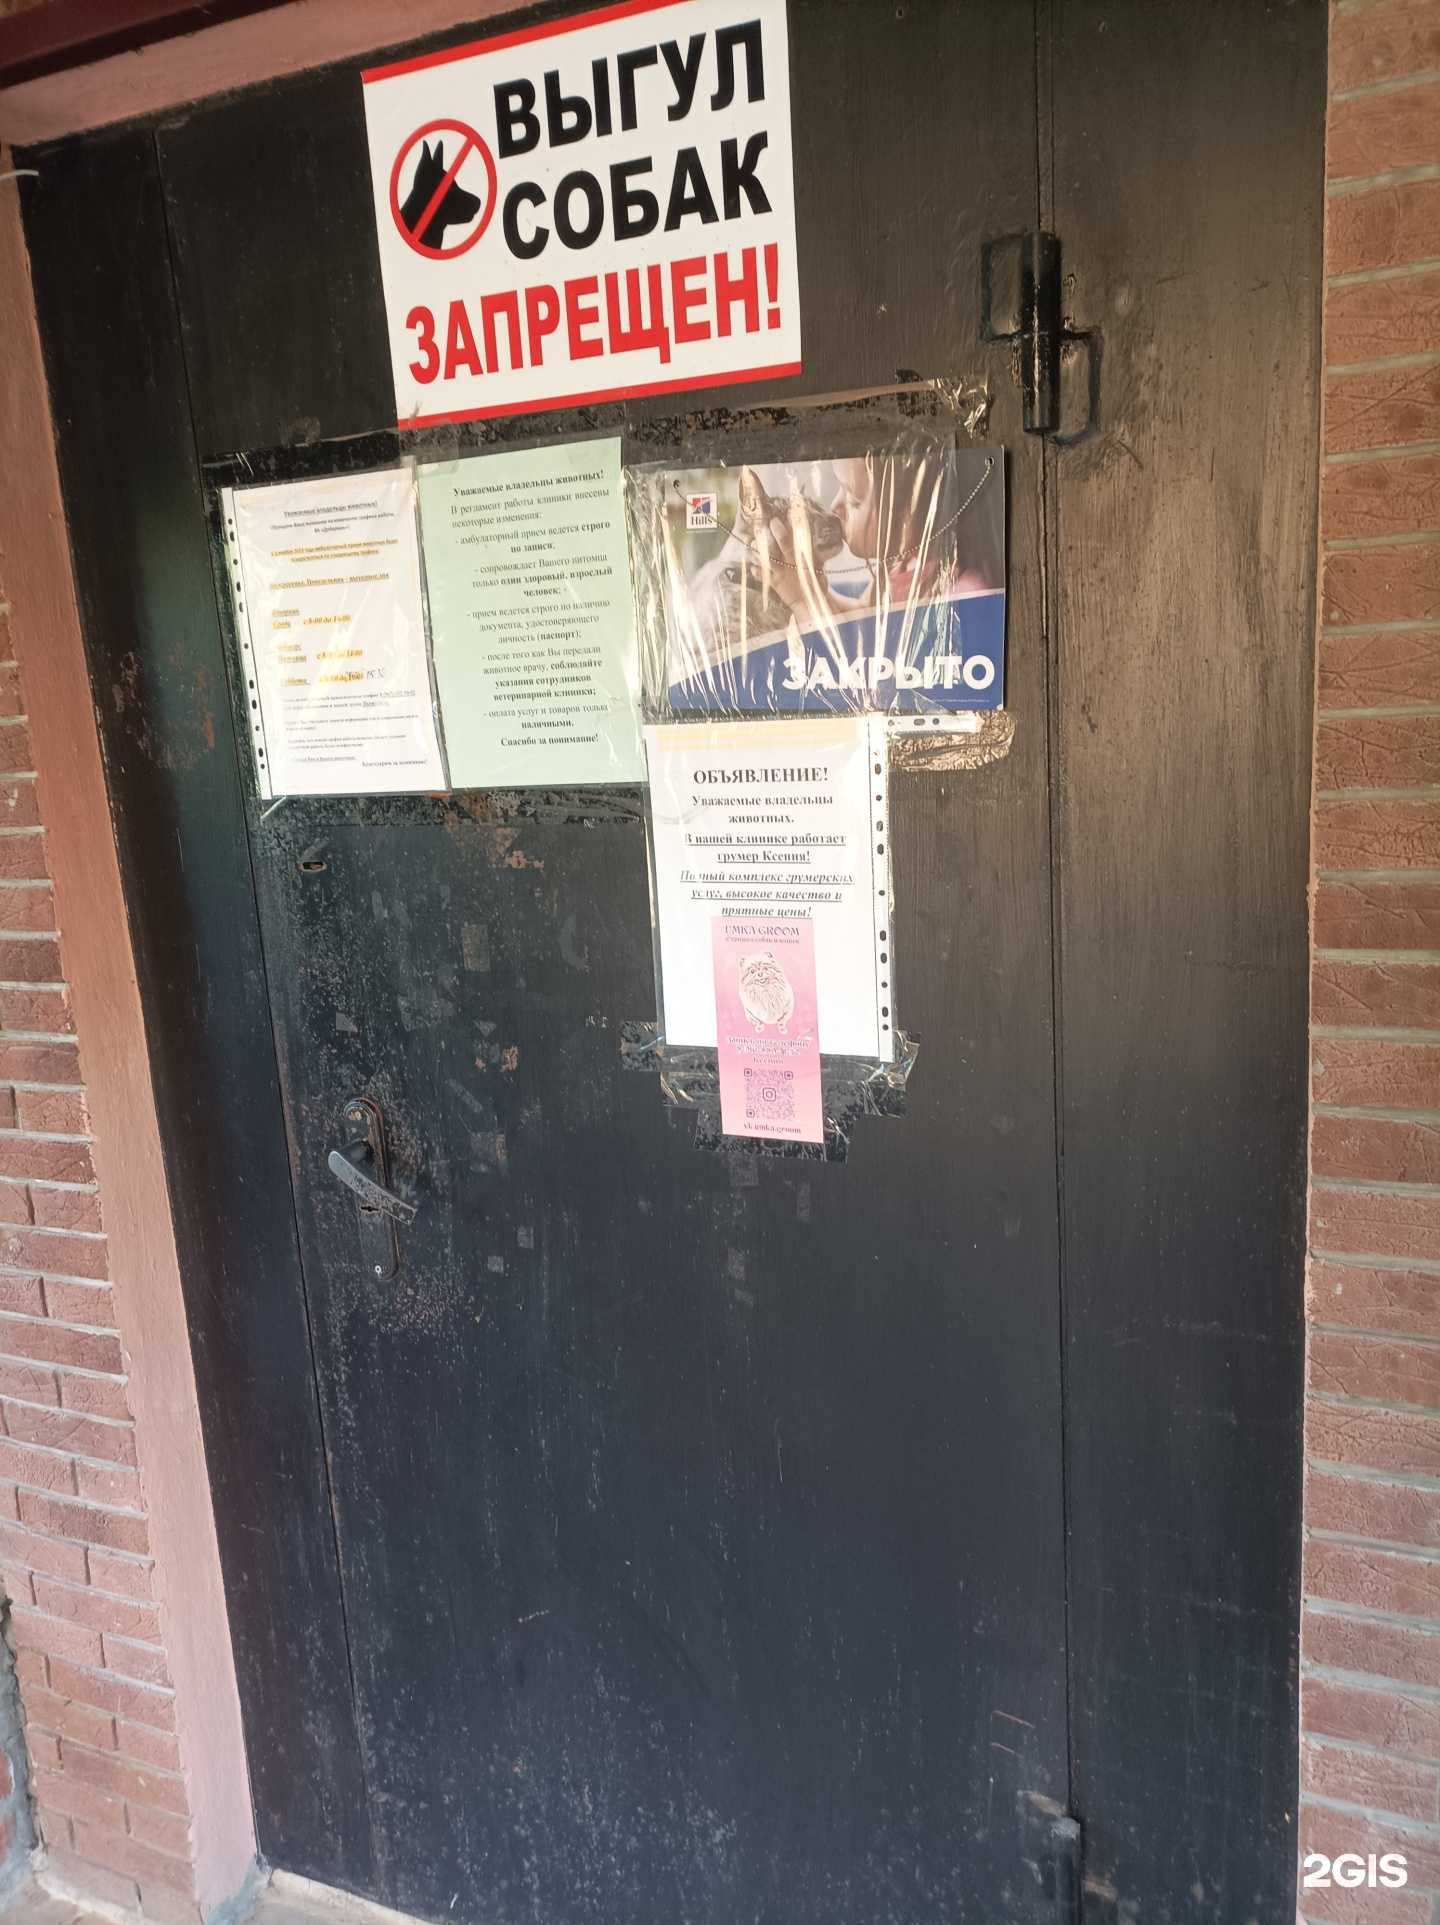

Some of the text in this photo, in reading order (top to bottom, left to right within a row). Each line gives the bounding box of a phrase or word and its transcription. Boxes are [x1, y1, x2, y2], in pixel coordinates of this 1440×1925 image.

[493, 18, 765, 159] ВЫГУЛ
[503, 130, 772, 260] СОБАК
[406, 242, 780, 384] ЗАПРЕЩЕН!
[453, 469, 604, 497] Уважаемые владельцы животных!
[460, 501, 500, 516] регламент
[504, 496, 534, 511] работы
[537, 494, 572, 506] клиники
[452, 517, 498, 529] некоторые
[461, 530, 519, 546] амбулаторный
[581, 520, 611, 533] строго
[480, 562, 536, 575] сопровождает
[473, 579, 499, 589] только
[501, 577, 521, 587] один
[570, 565, 613, 581] взрослый
[532, 604, 558, 615] строго
[498, 633, 535, 644] личность
[487, 653, 510, 662] после
[513, 651, 530, 660] того
[532, 650, 545, 658] как
[547, 647, 562, 657] Вы
[483, 666, 521, 675] животное
[551, 659, 602, 671] соблюдайте
[783, 655, 995, 690] ЗАКРЫТО
[495, 675, 592, 690] указания сотрудников
[494, 689, 552, 702] ветеринарной
[501, 732, 599, 747] Спасибо за понимание!
[693, 767, 828, 785] ОБЪЯВЛЕНИЕ!
[691, 795, 833, 807] Уважаемые владельцы
[728, 814, 795, 824] животных.
[695, 832, 732, 844] нашей
[736, 834, 788, 845] клинике
[790, 832, 846, 846] работает
[717, 850, 811, 864] грумер Ксения!
[729, 871, 782, 882] комплекс
[784, 873, 853, 885] грумерских
[724, 890, 772, 899] высокое
[775, 890, 832, 901] качество
[834, 891, 842, 900] и
[777, 905, 812, 918] цены!
